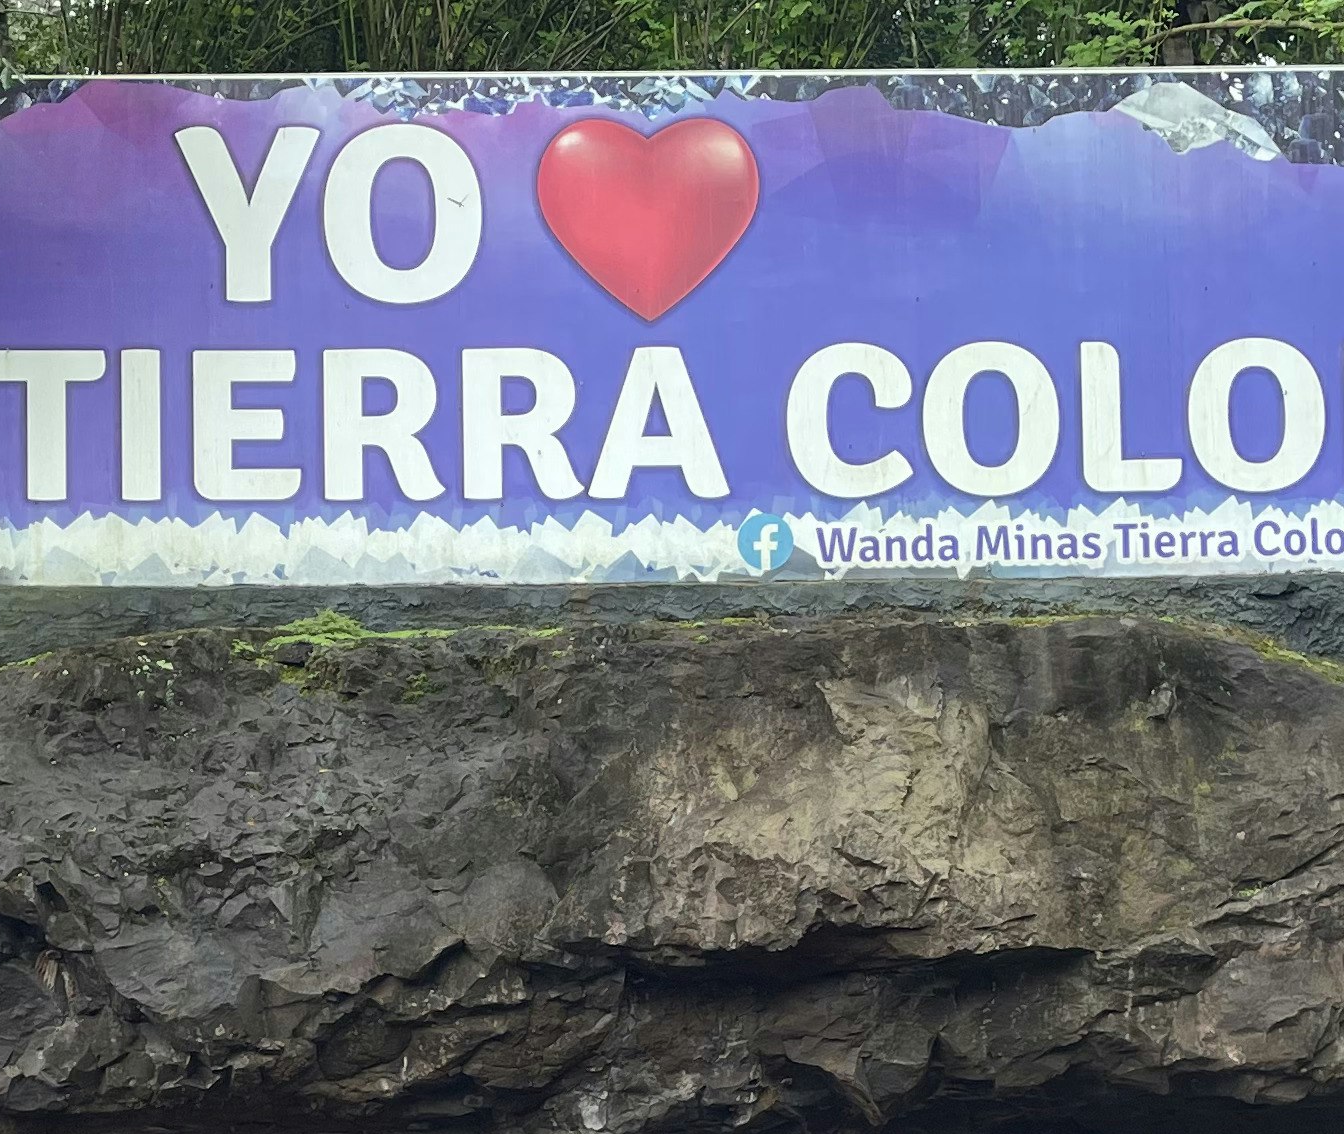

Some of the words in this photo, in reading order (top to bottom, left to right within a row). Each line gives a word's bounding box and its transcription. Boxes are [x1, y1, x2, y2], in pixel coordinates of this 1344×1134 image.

[175, 124, 483, 304] YO
[815, 522, 958, 563] Wanda
[976, 522, 1102, 561] Minas
[1113, 522, 1240, 559] Tierra
